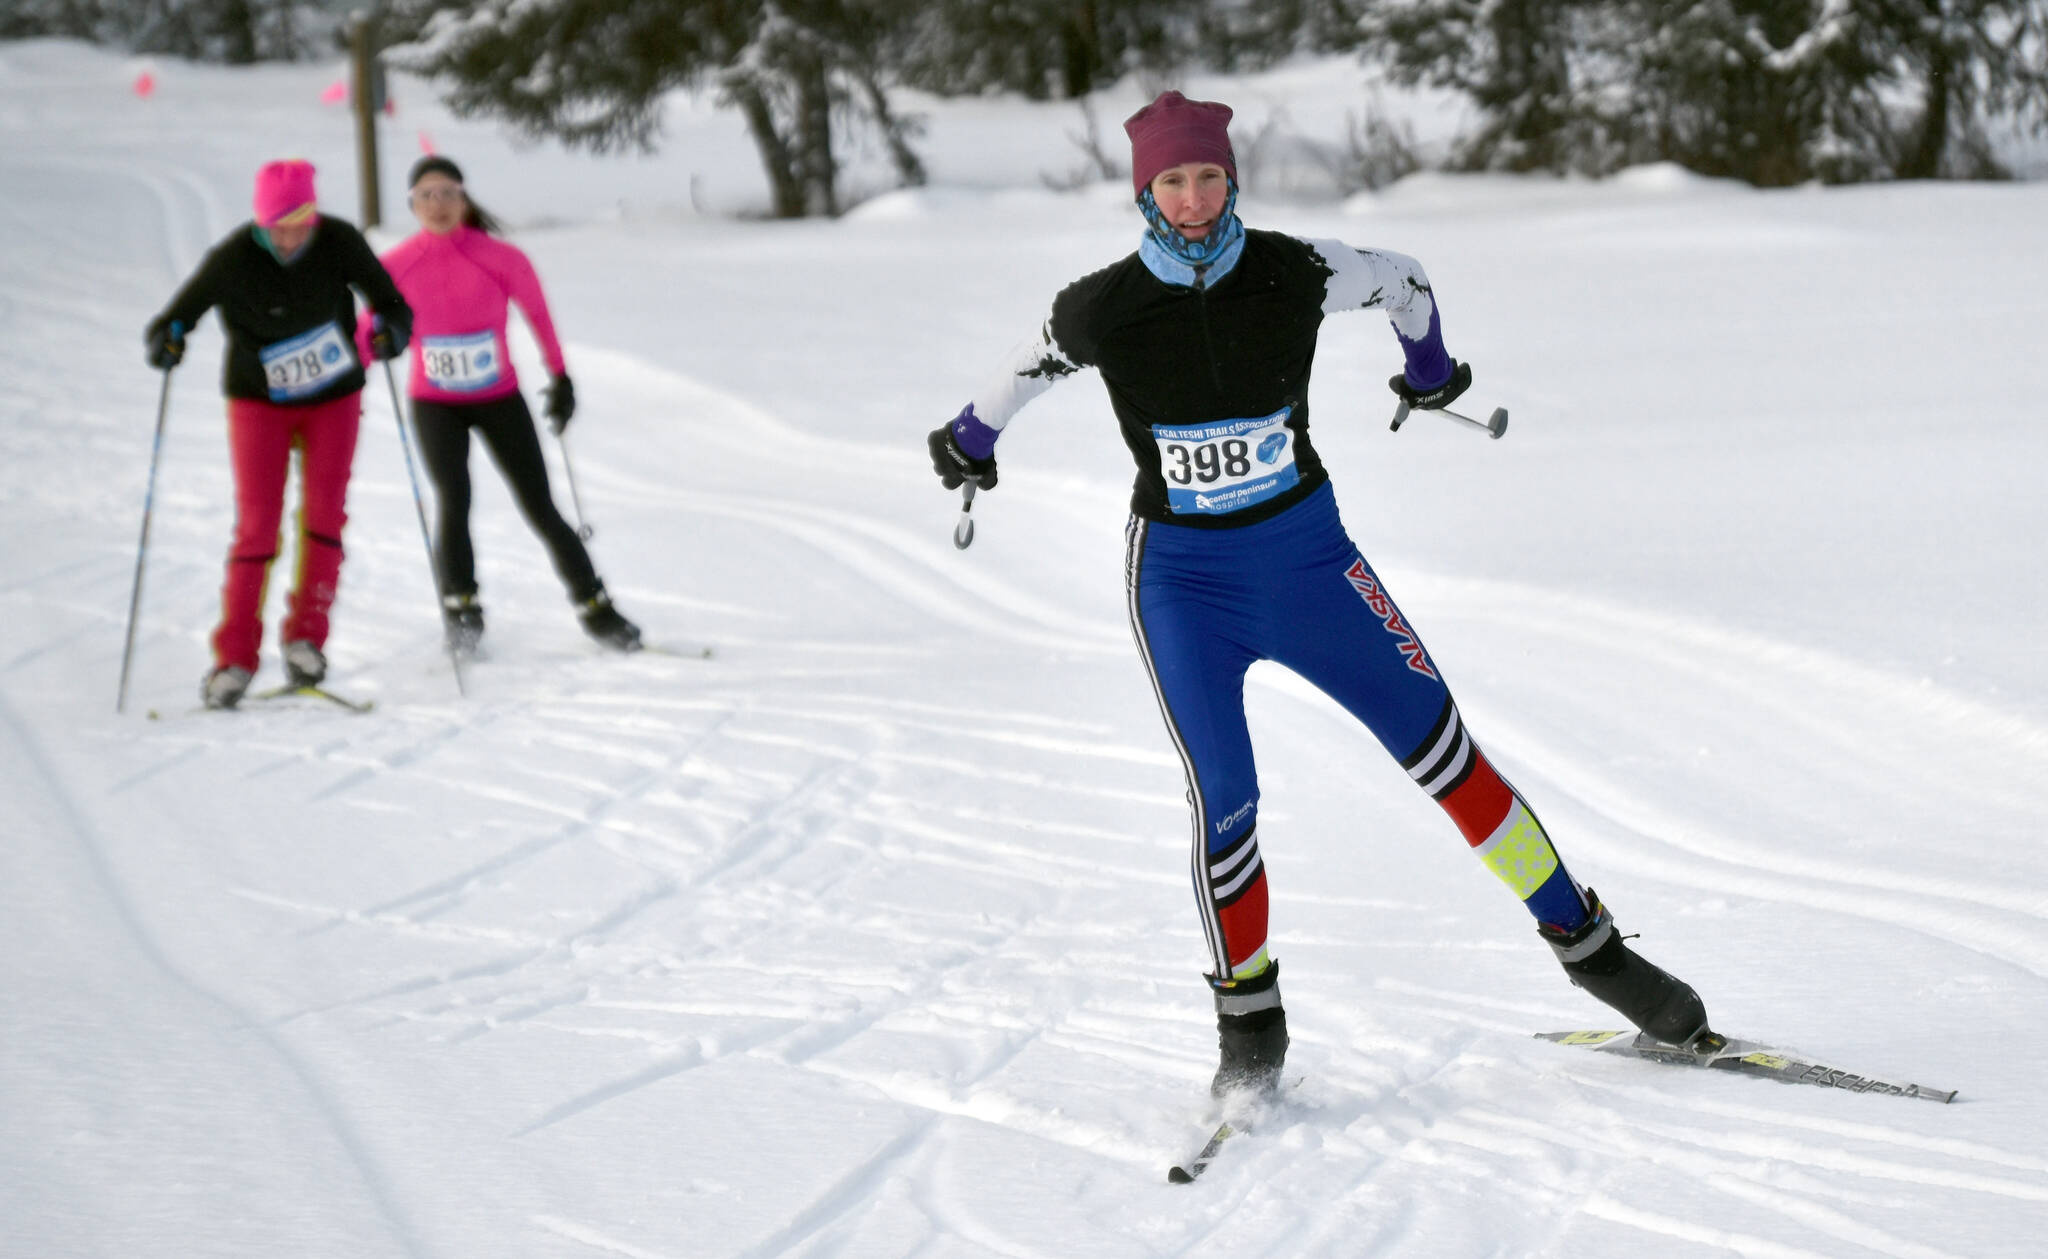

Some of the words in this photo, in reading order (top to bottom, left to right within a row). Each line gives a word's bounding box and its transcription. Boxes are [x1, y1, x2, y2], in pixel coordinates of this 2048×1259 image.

[271, 350, 321, 383] 378
[425, 350, 468, 376] 381
[1204, 424, 1236, 438] TRAILS
[1167, 439, 1251, 485] 398
[1208, 489, 1237, 503] central
[1237, 479, 1278, 497] peninsula
[1210, 497, 1250, 511] hospital
[1344, 558, 1438, 681] ALASKA
